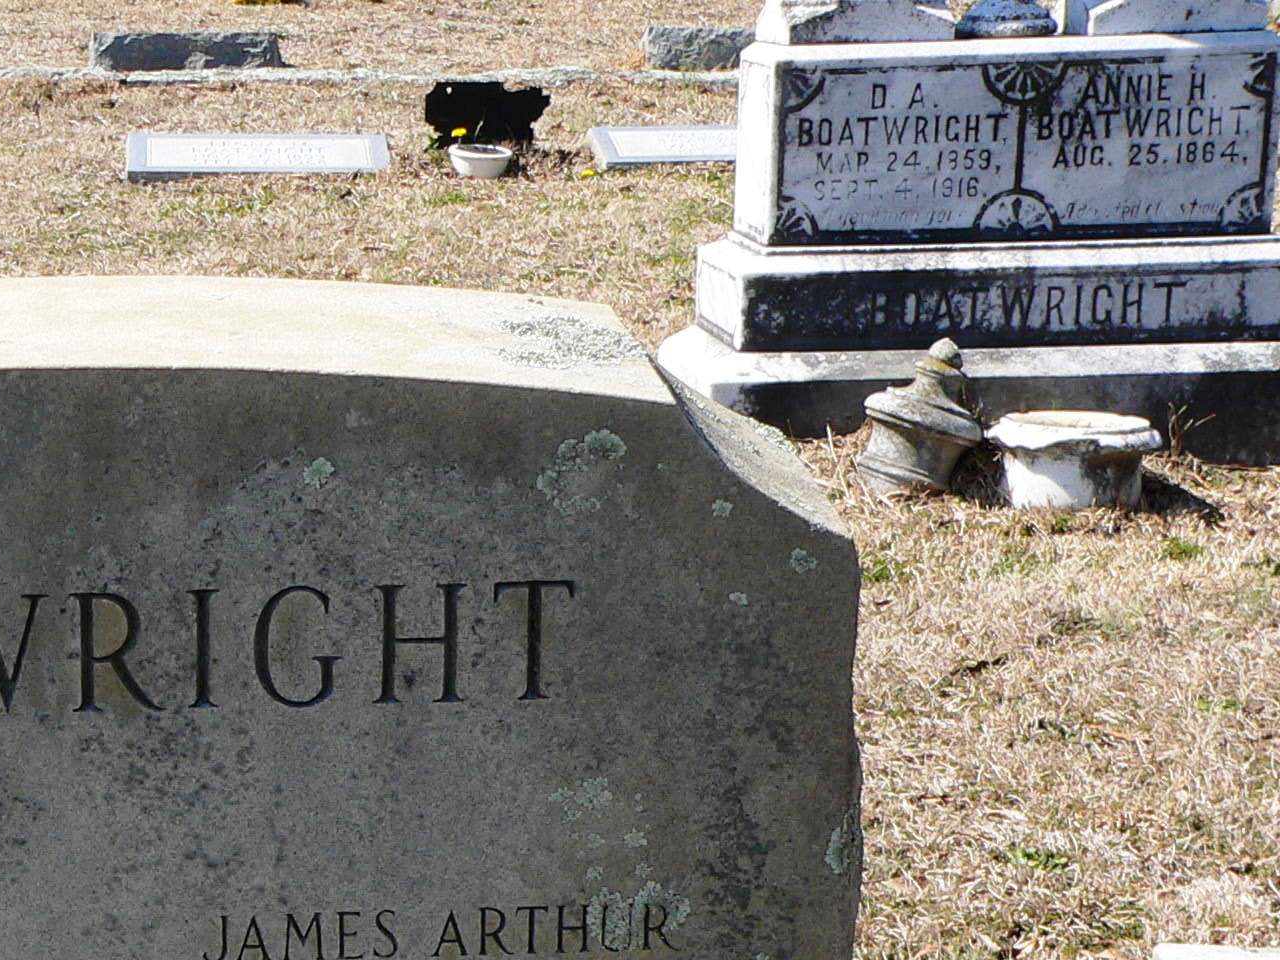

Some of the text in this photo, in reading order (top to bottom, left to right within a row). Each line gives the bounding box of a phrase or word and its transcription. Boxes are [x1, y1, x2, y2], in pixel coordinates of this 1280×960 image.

[871, 82, 939, 109] D. A.
[1081, 68, 1217, 104] ANNIE H.
[867, 279, 1189, 329] BOATWRIGHT
[431, 902, 682, 958] ARTHUR
